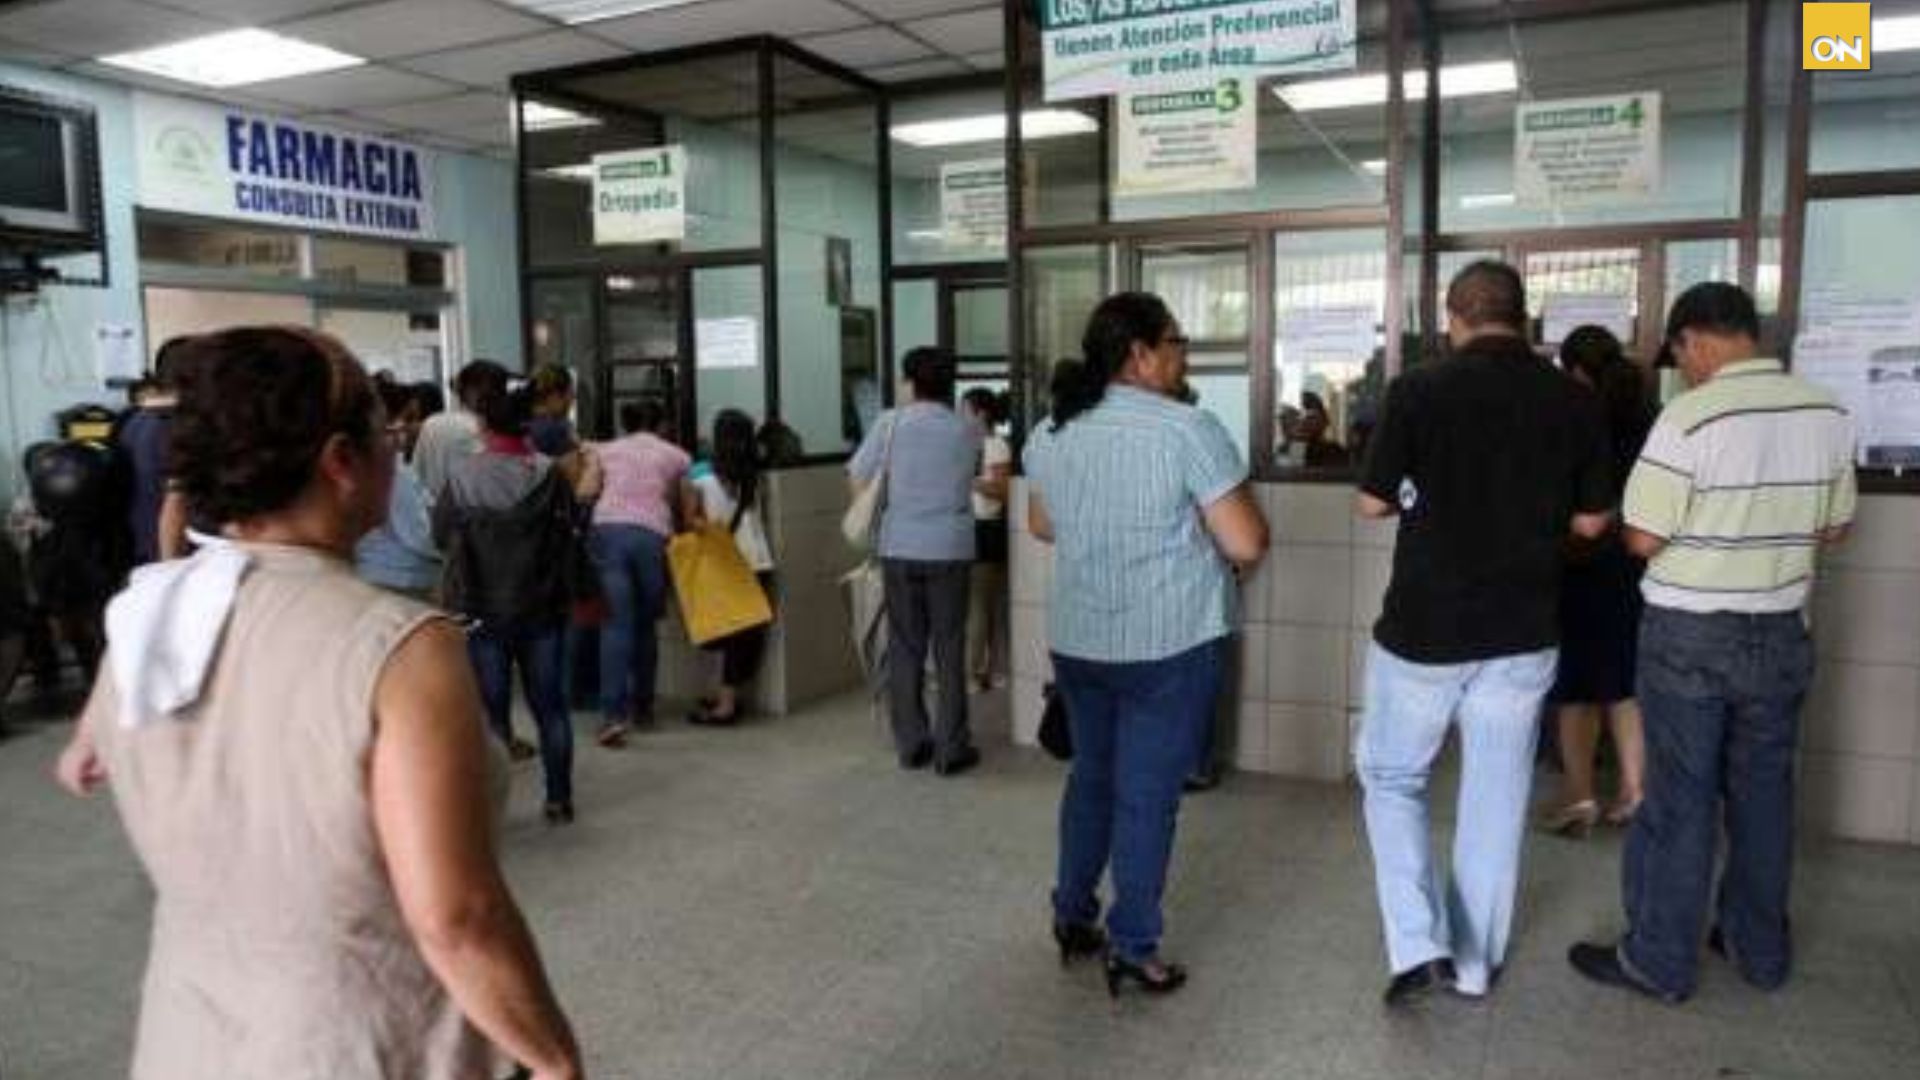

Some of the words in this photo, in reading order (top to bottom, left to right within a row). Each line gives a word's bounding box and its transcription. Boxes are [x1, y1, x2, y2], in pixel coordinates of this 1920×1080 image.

[1119, 19, 1206, 49] Atención
[1212, 1, 1341, 36] Preferencial
[1131, 56, 1154, 75] en
[1217, 77, 1242, 113] 3
[1617, 97, 1644, 129] 4
[225, 115, 423, 200] FARMACIA
[235, 181, 339, 221] CONSULTA
[345, 197, 421, 231] EXTERNA
